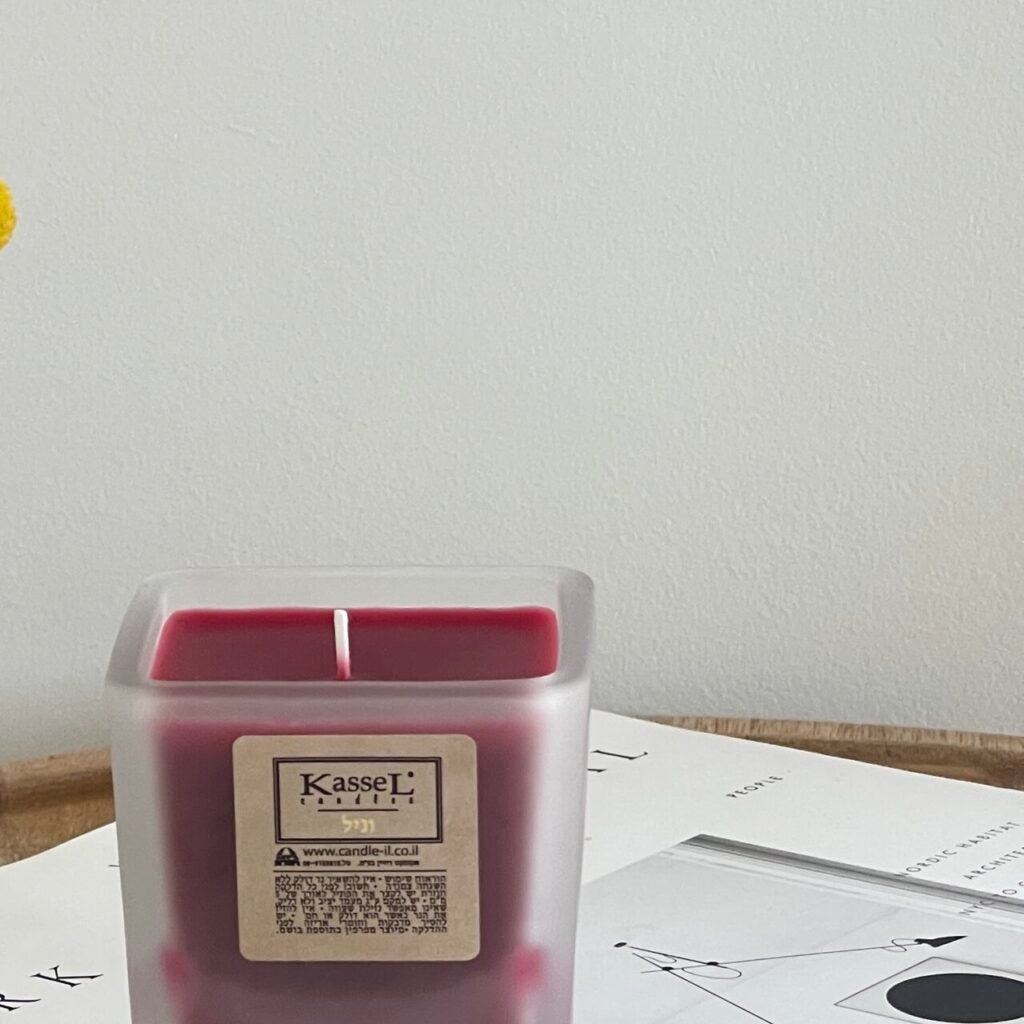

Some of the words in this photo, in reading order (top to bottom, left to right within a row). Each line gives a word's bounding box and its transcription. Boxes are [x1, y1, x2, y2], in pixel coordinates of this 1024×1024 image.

[726, 775, 783, 799] PEOPLE
[342, 815, 375, 833] וניל
[303, 845, 419, 857] www.candle-il.co.il
[894, 849, 957, 878] NORDIC
[956, 822, 1020, 848] HABITAT
[962, 846, 1024, 880] ARCHITE
